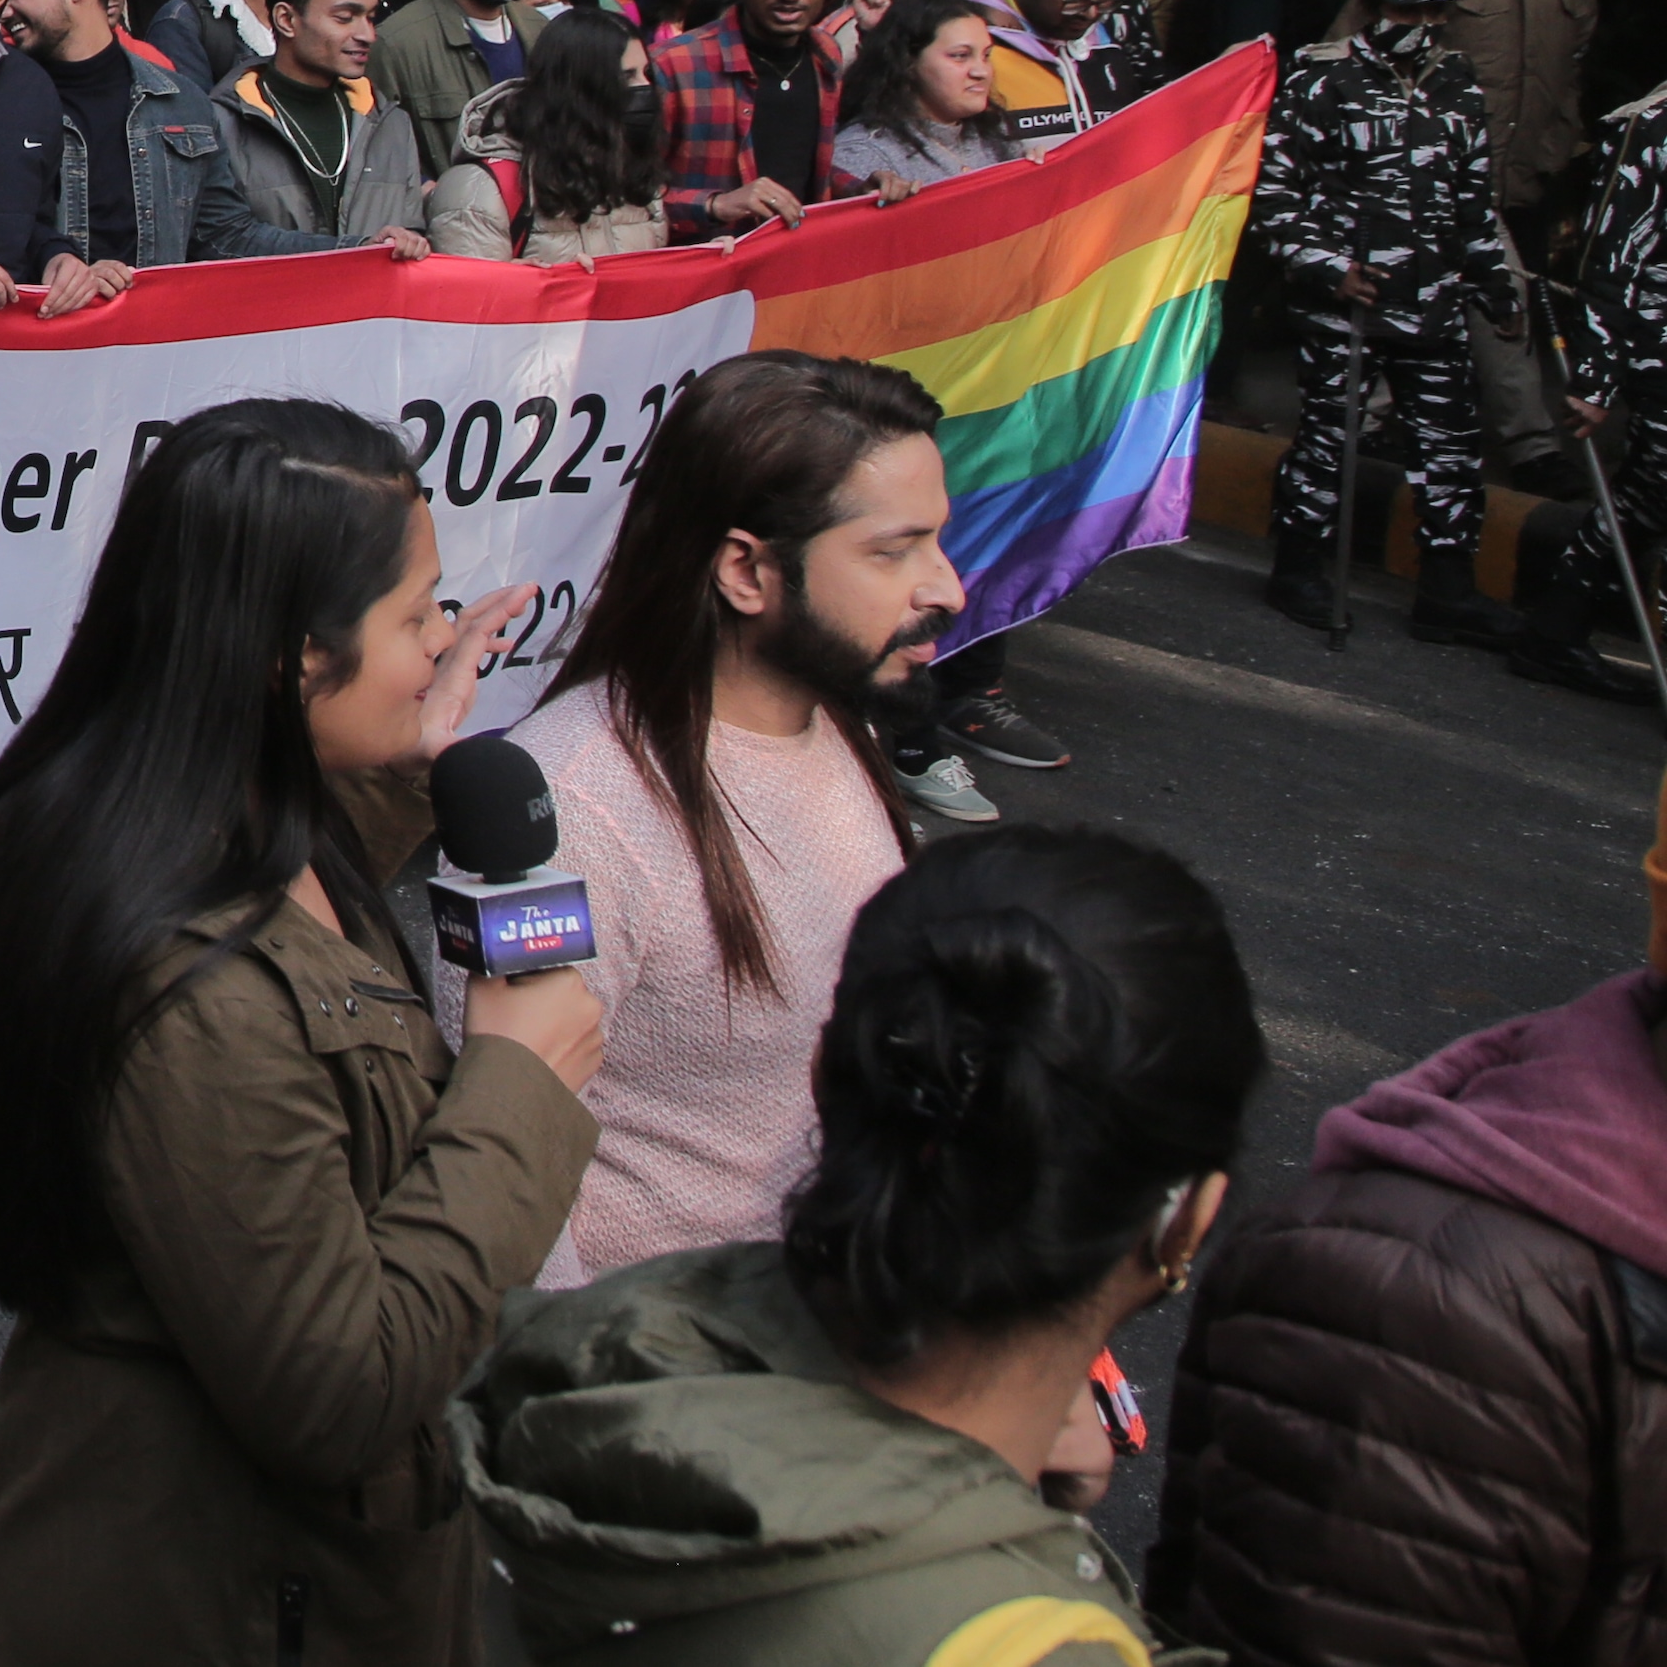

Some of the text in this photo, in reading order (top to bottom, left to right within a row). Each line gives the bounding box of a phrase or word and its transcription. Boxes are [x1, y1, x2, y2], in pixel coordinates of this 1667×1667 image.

[1018, 112, 1088, 129] OLYMPC
[400, 369, 697, 507] 2022-2
[521, 906, 551, 922] The
[499, 915, 581, 943] JANTA
